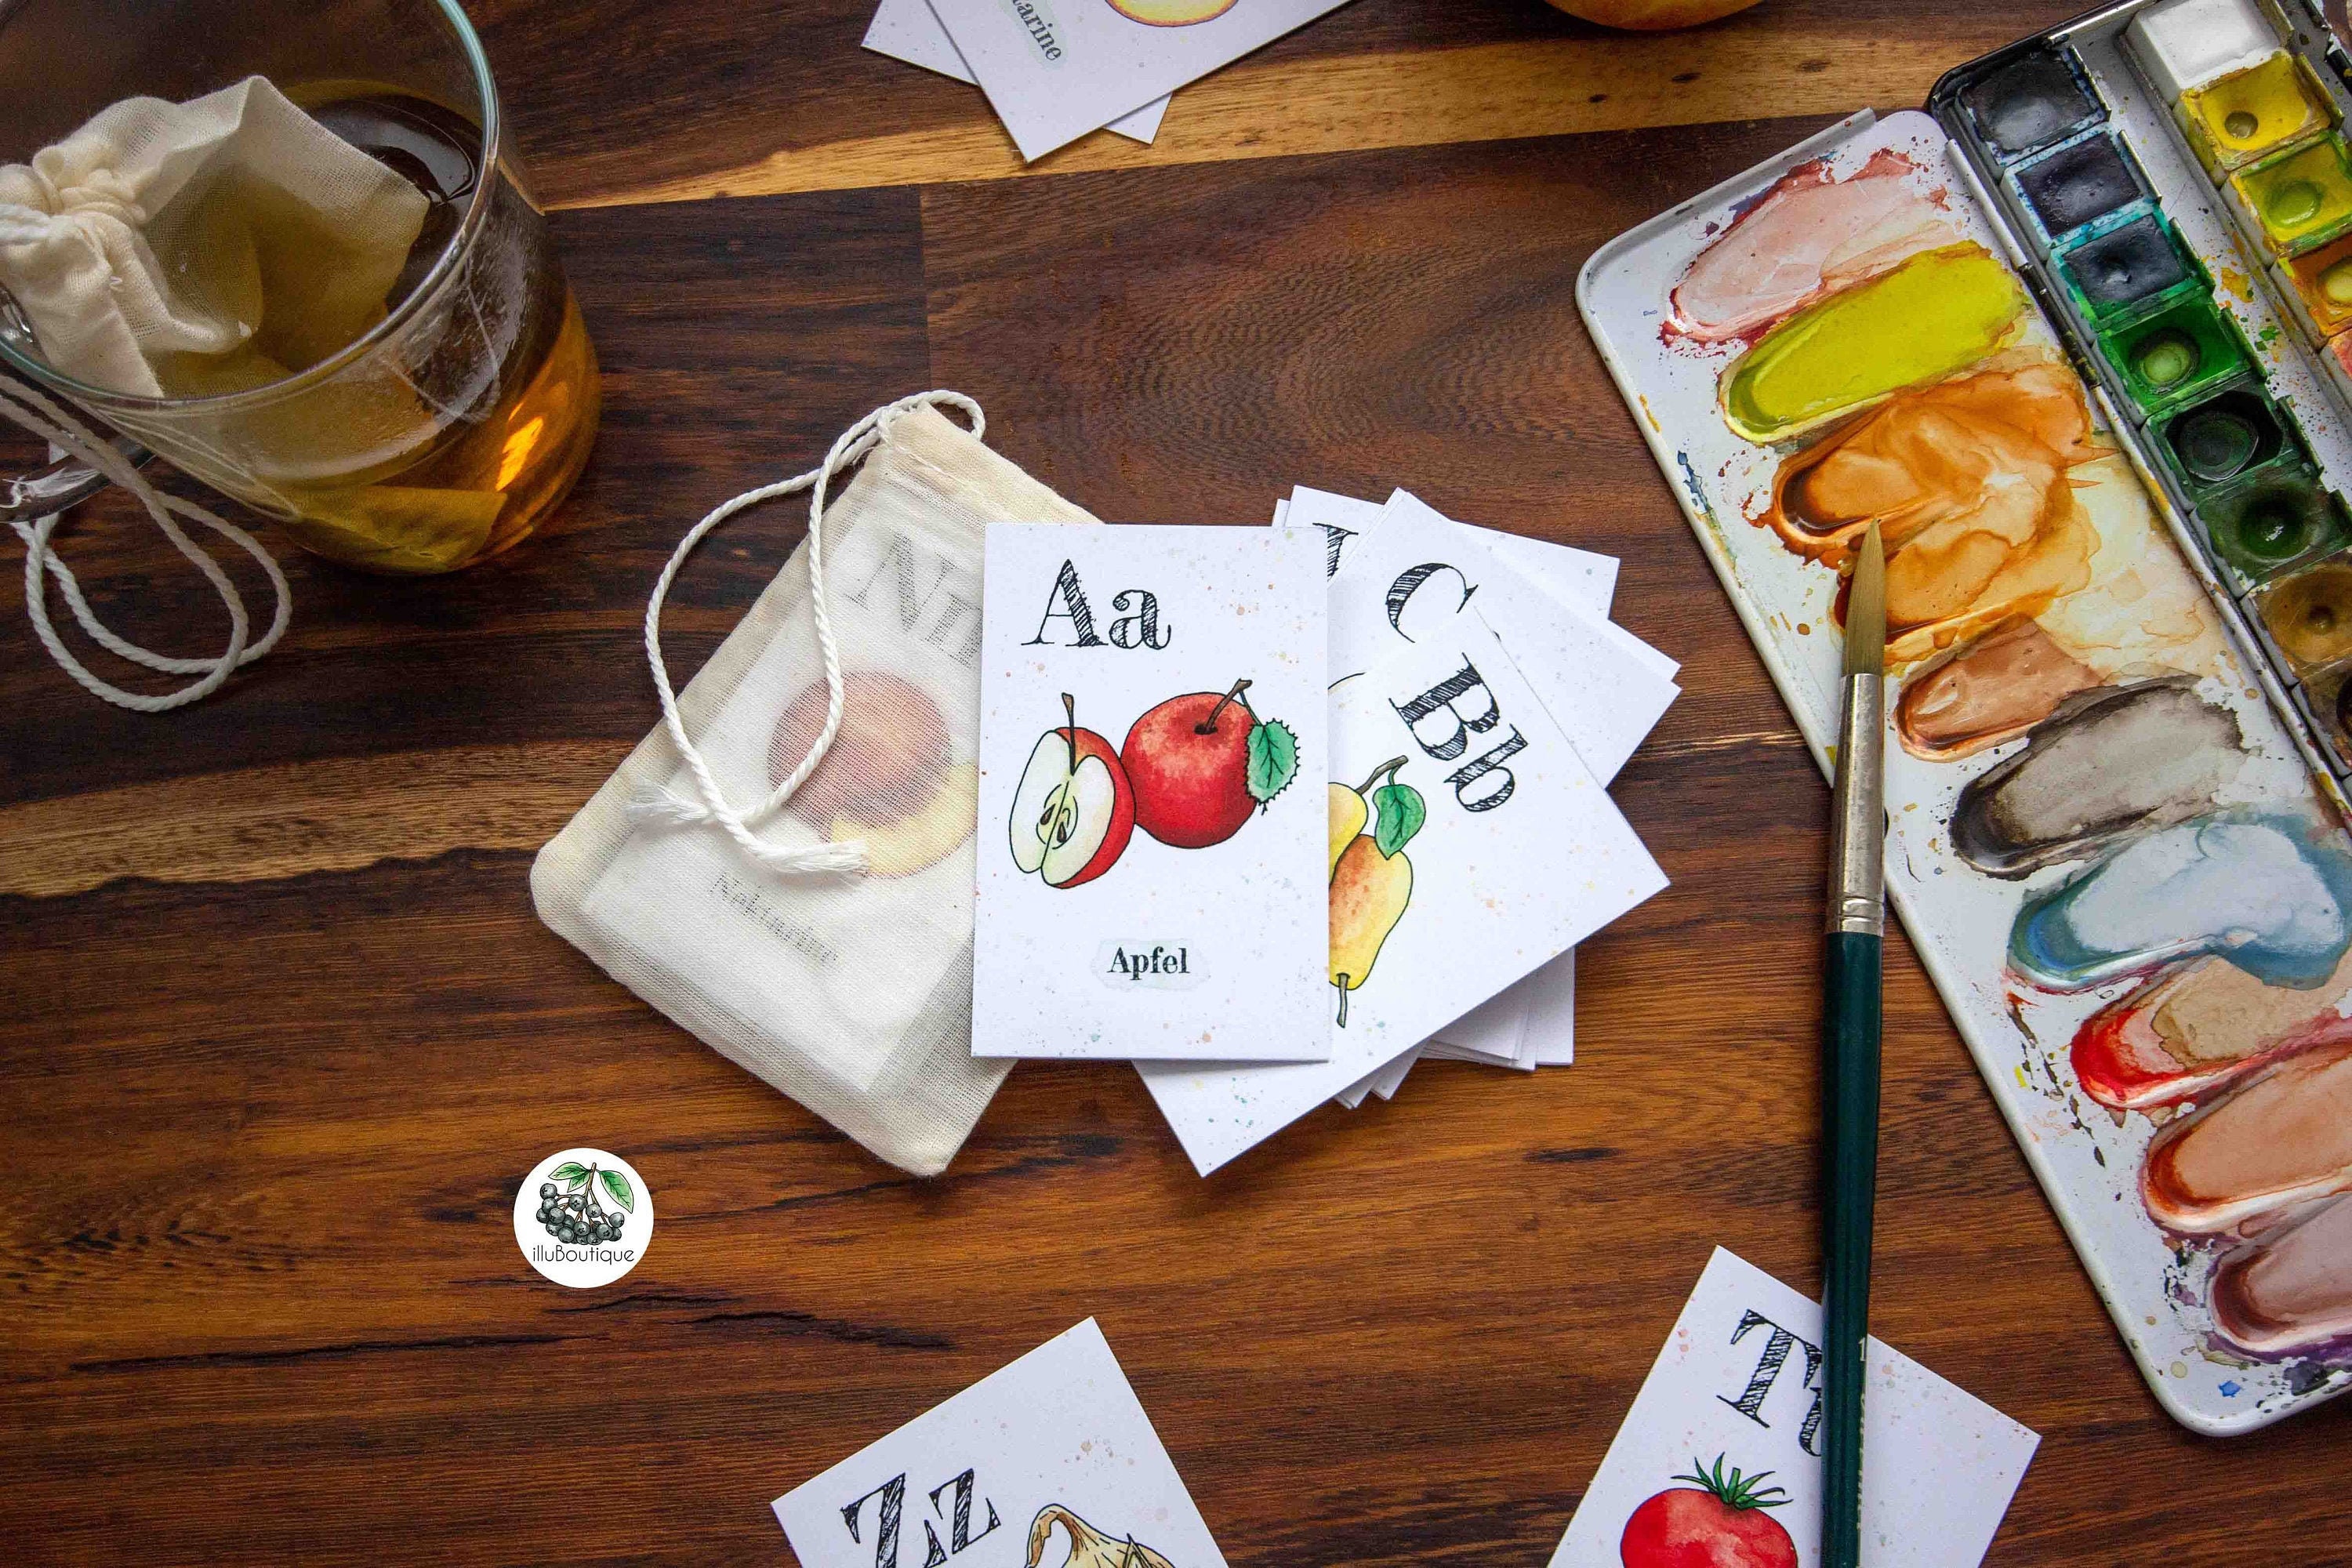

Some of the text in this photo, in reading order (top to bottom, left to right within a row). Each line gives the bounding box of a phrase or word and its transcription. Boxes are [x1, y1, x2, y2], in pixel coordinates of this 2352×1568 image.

[1021, 559, 1171, 650] Aa
[1385, 562, 1501, 644] C
[1388, 652, 1528, 812] Bb
[1106, 946, 1191, 981] Apfel
[840, 1468, 1001, 1568] Zz
